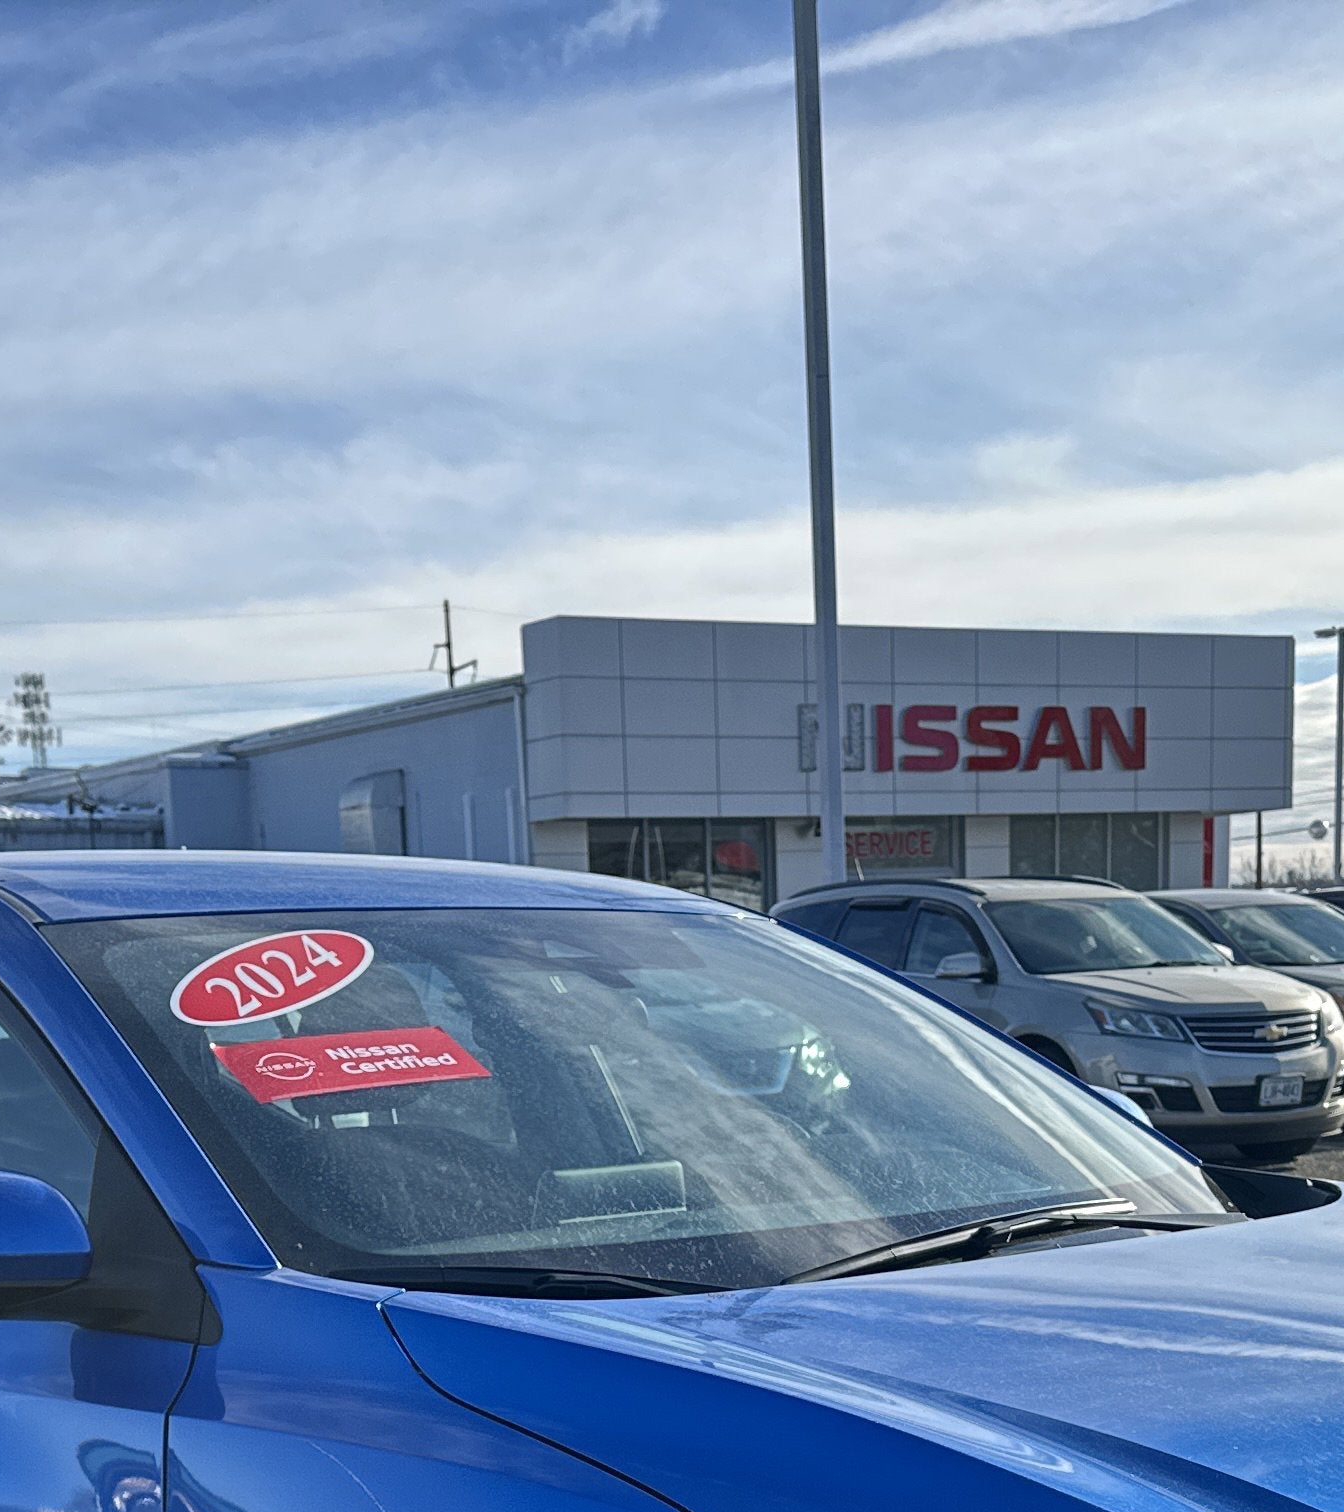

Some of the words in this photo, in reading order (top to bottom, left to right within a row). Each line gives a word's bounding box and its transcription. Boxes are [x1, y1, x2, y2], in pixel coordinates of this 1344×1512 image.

[845, 829, 933, 857] SERVICE
[205, 935, 343, 1017] 2024
[325, 1043, 420, 1060] Nissan
[256, 1060, 316, 1073] NISSAN
[340, 1053, 458, 1074] Certified
